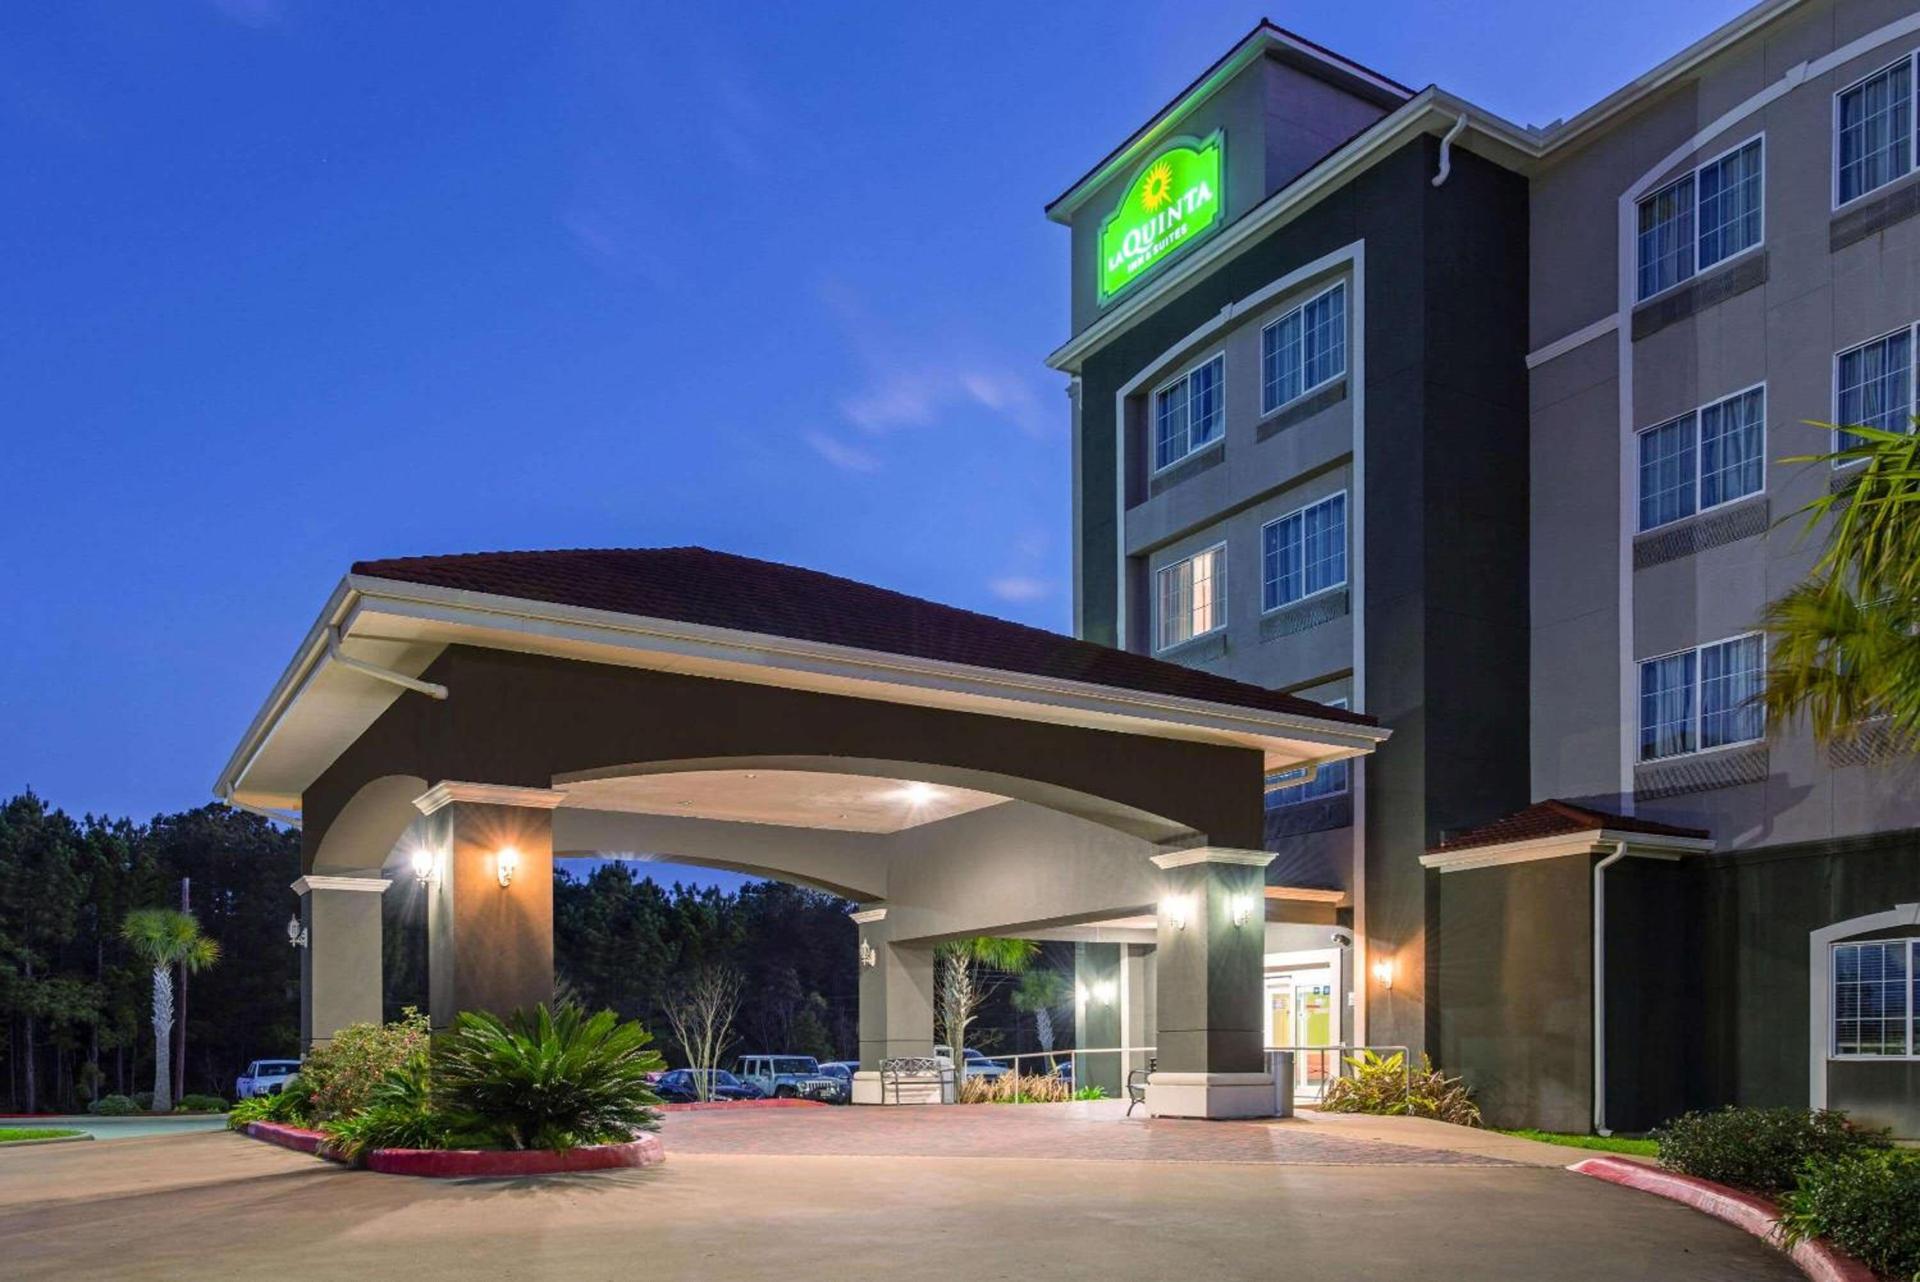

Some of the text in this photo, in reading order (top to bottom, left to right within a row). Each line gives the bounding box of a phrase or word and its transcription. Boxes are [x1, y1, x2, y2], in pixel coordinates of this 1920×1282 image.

[1108, 181, 1212, 271] LA QUINTA
[1153, 224, 1188, 254] SUITES
